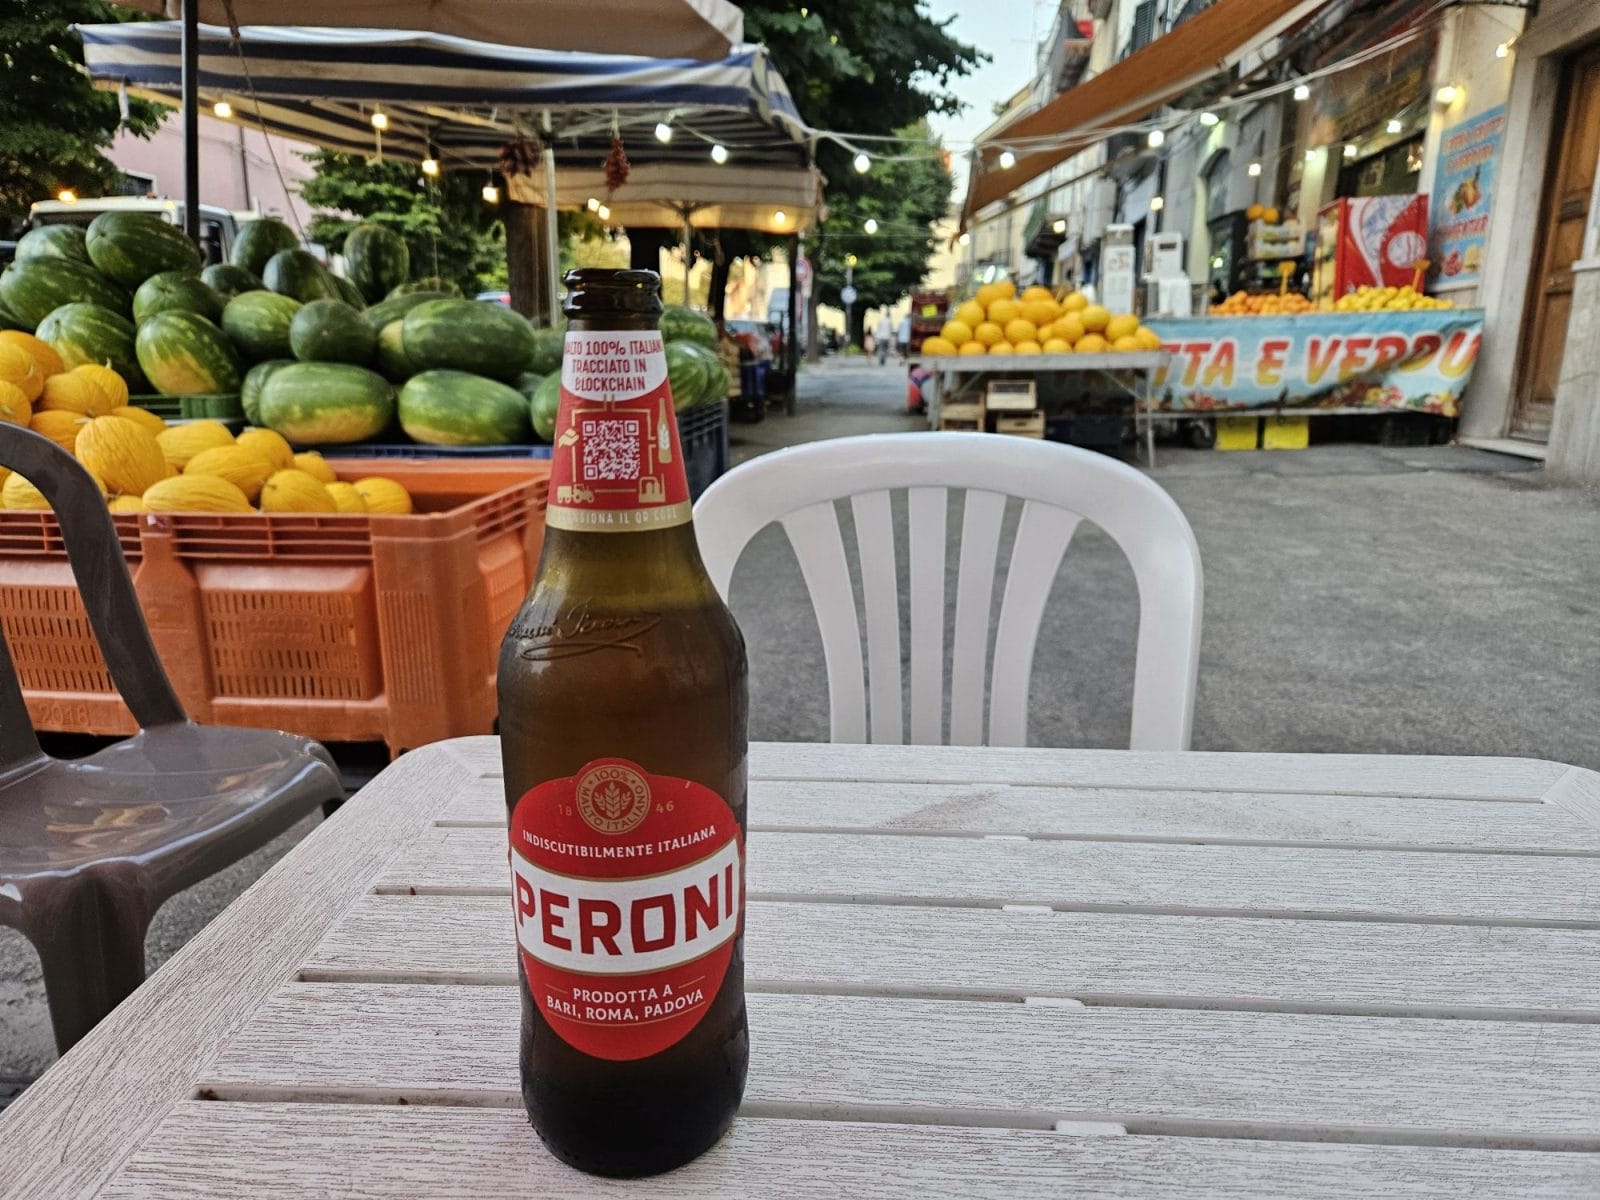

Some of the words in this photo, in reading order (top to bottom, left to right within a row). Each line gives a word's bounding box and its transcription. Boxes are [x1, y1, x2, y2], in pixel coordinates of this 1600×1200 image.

[586, 341, 626, 356] 100%
[572, 359, 631, 374] TRACCIATO
[634, 358, 648, 373] IN
[1254, 341, 1290, 386] E
[575, 376, 646, 391] BLOCKCHAIN
[594, 769, 630, 782] 100%
[581, 786, 604, 826] MALTO
[607, 786, 645, 830] ITALIANO
[656, 800, 674, 814] 46
[522, 829, 653, 858] INDISCUTIBILMENTE
[658, 824, 716, 853] ITALIANA
[514, 862, 733, 956] PERONI
[573, 986, 659, 1004] PRODOTTA
[662, 984, 673, 997] A
[547, 995, 581, 1020] BARI,
[586, 1006, 639, 1021] ROMA,
[644, 988, 704, 1019] PADOVA
